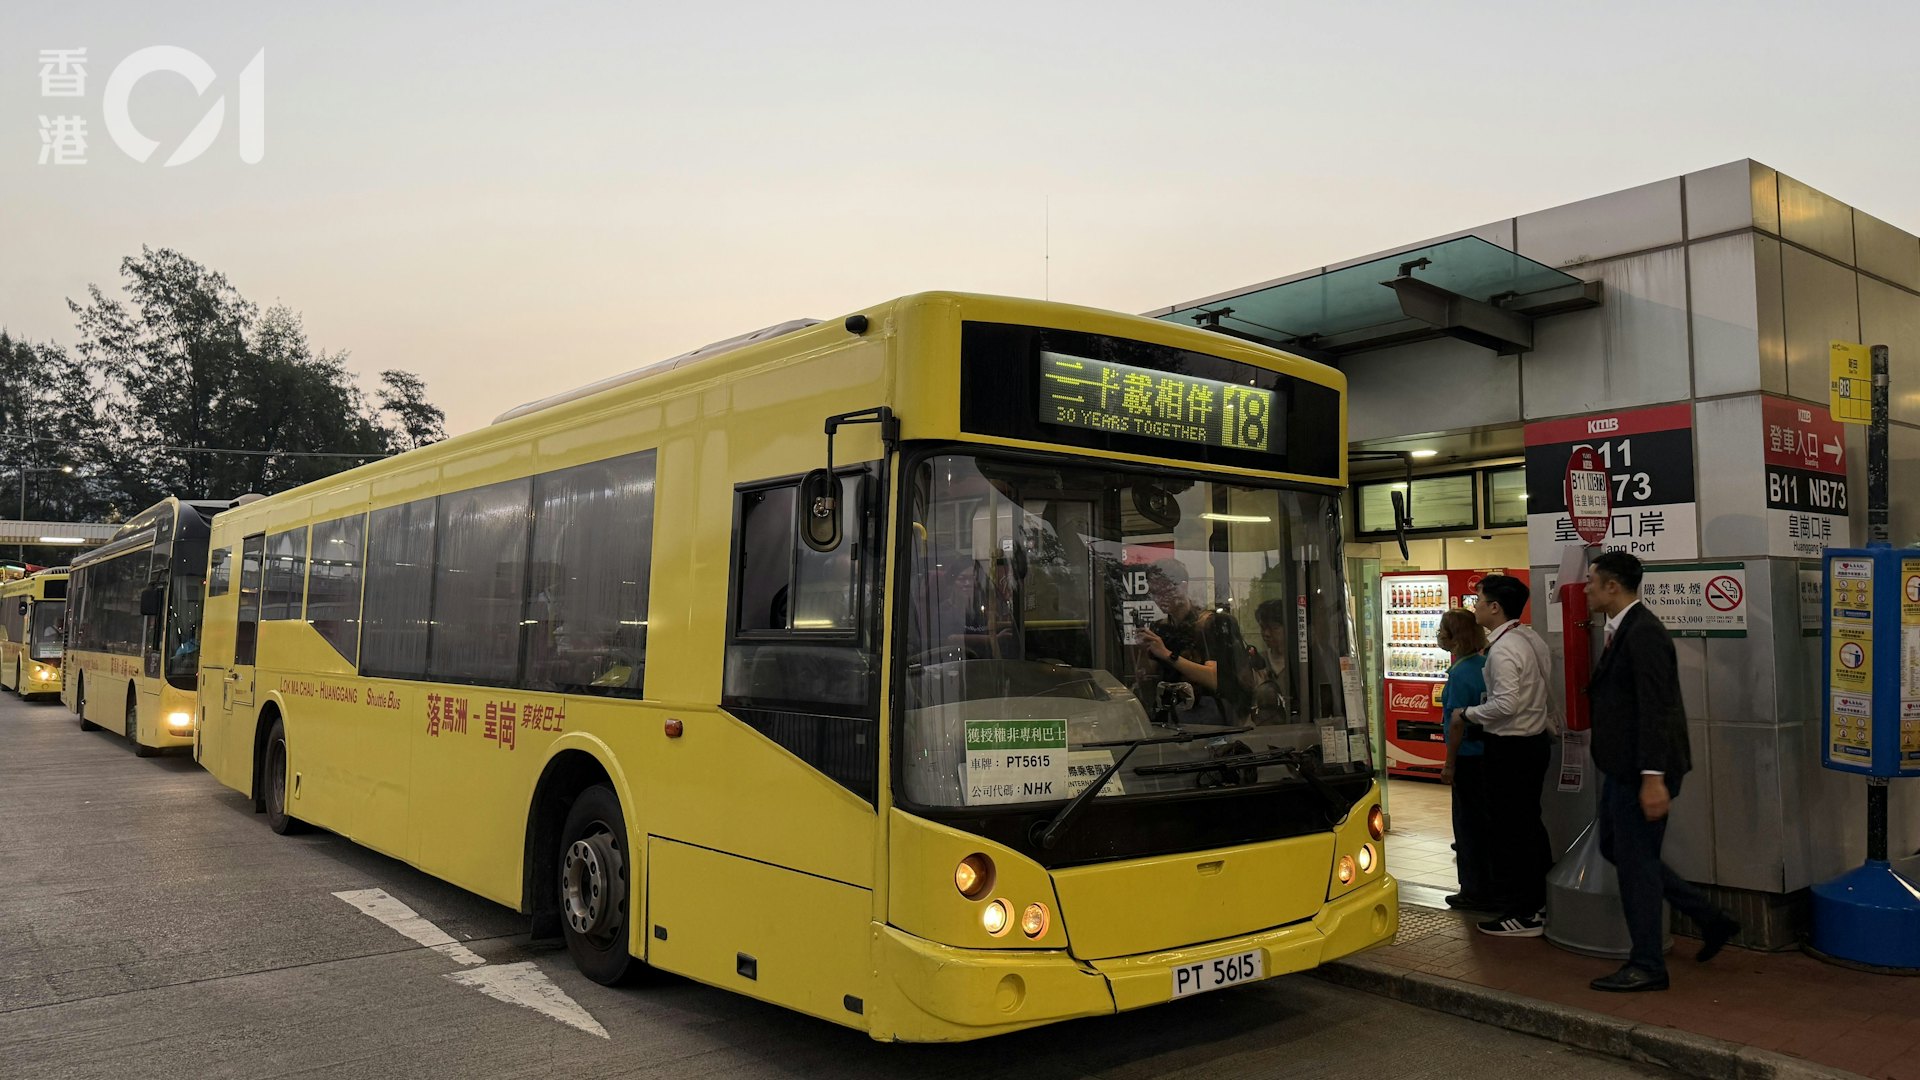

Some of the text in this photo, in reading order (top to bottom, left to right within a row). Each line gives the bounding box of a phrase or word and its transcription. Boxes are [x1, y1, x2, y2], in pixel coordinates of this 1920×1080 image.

[1056, 405, 1207, 442] 30 YEARS TOGETHER
[1587, 417, 1620, 434] KMB
[1770, 424, 1819, 458] 登車入口
[1571, 472, 1586, 490] B11
[1769, 472, 1847, 510] B11 NB73
[1554, 510, 1665, 543] 皇口岸
[1789, 513, 1832, 541] 皇崗口岸
[1631, 541, 1655, 553] Port
[1643, 583, 1701, 595] 嚴禁吸煙
[1644, 597, 1702, 607] No Smoking
[1677, 615, 1703, 625] $3,000
[320, 681, 358, 704] HUANGGANG
[366, 687, 386, 708] Shuttle
[387, 690, 401, 710] Bus
[427, 693, 468, 738] 落馬洲
[483, 700, 516, 751] 皇崗
[521, 703, 566, 733] 穿梭巴士
[967, 726, 1066, 743] 獲授權非專利巴士
[1006, 755, 1050, 769] PT5615
[1023, 782, 1053, 796] NHK
[1177, 953, 1254, 993] PT 5615
